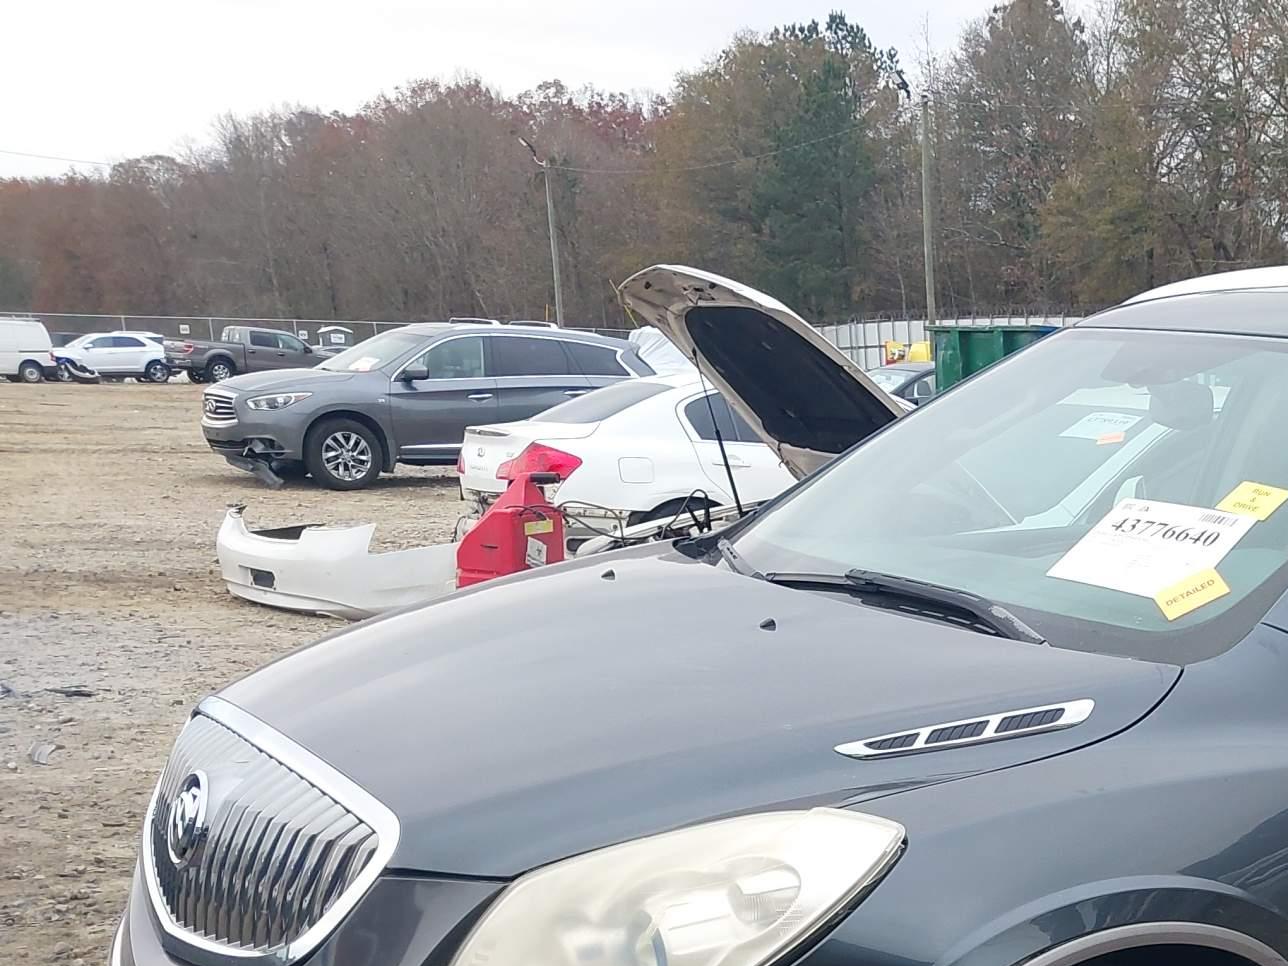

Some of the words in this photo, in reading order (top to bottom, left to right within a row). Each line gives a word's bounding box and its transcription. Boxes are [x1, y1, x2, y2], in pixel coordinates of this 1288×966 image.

[1252, 488, 1272, 497] RUN
[1233, 502, 1260, 512] DRIVE
[1112, 518, 1220, 547] 43776640
[1165, 579, 1215, 607] DETAILED
